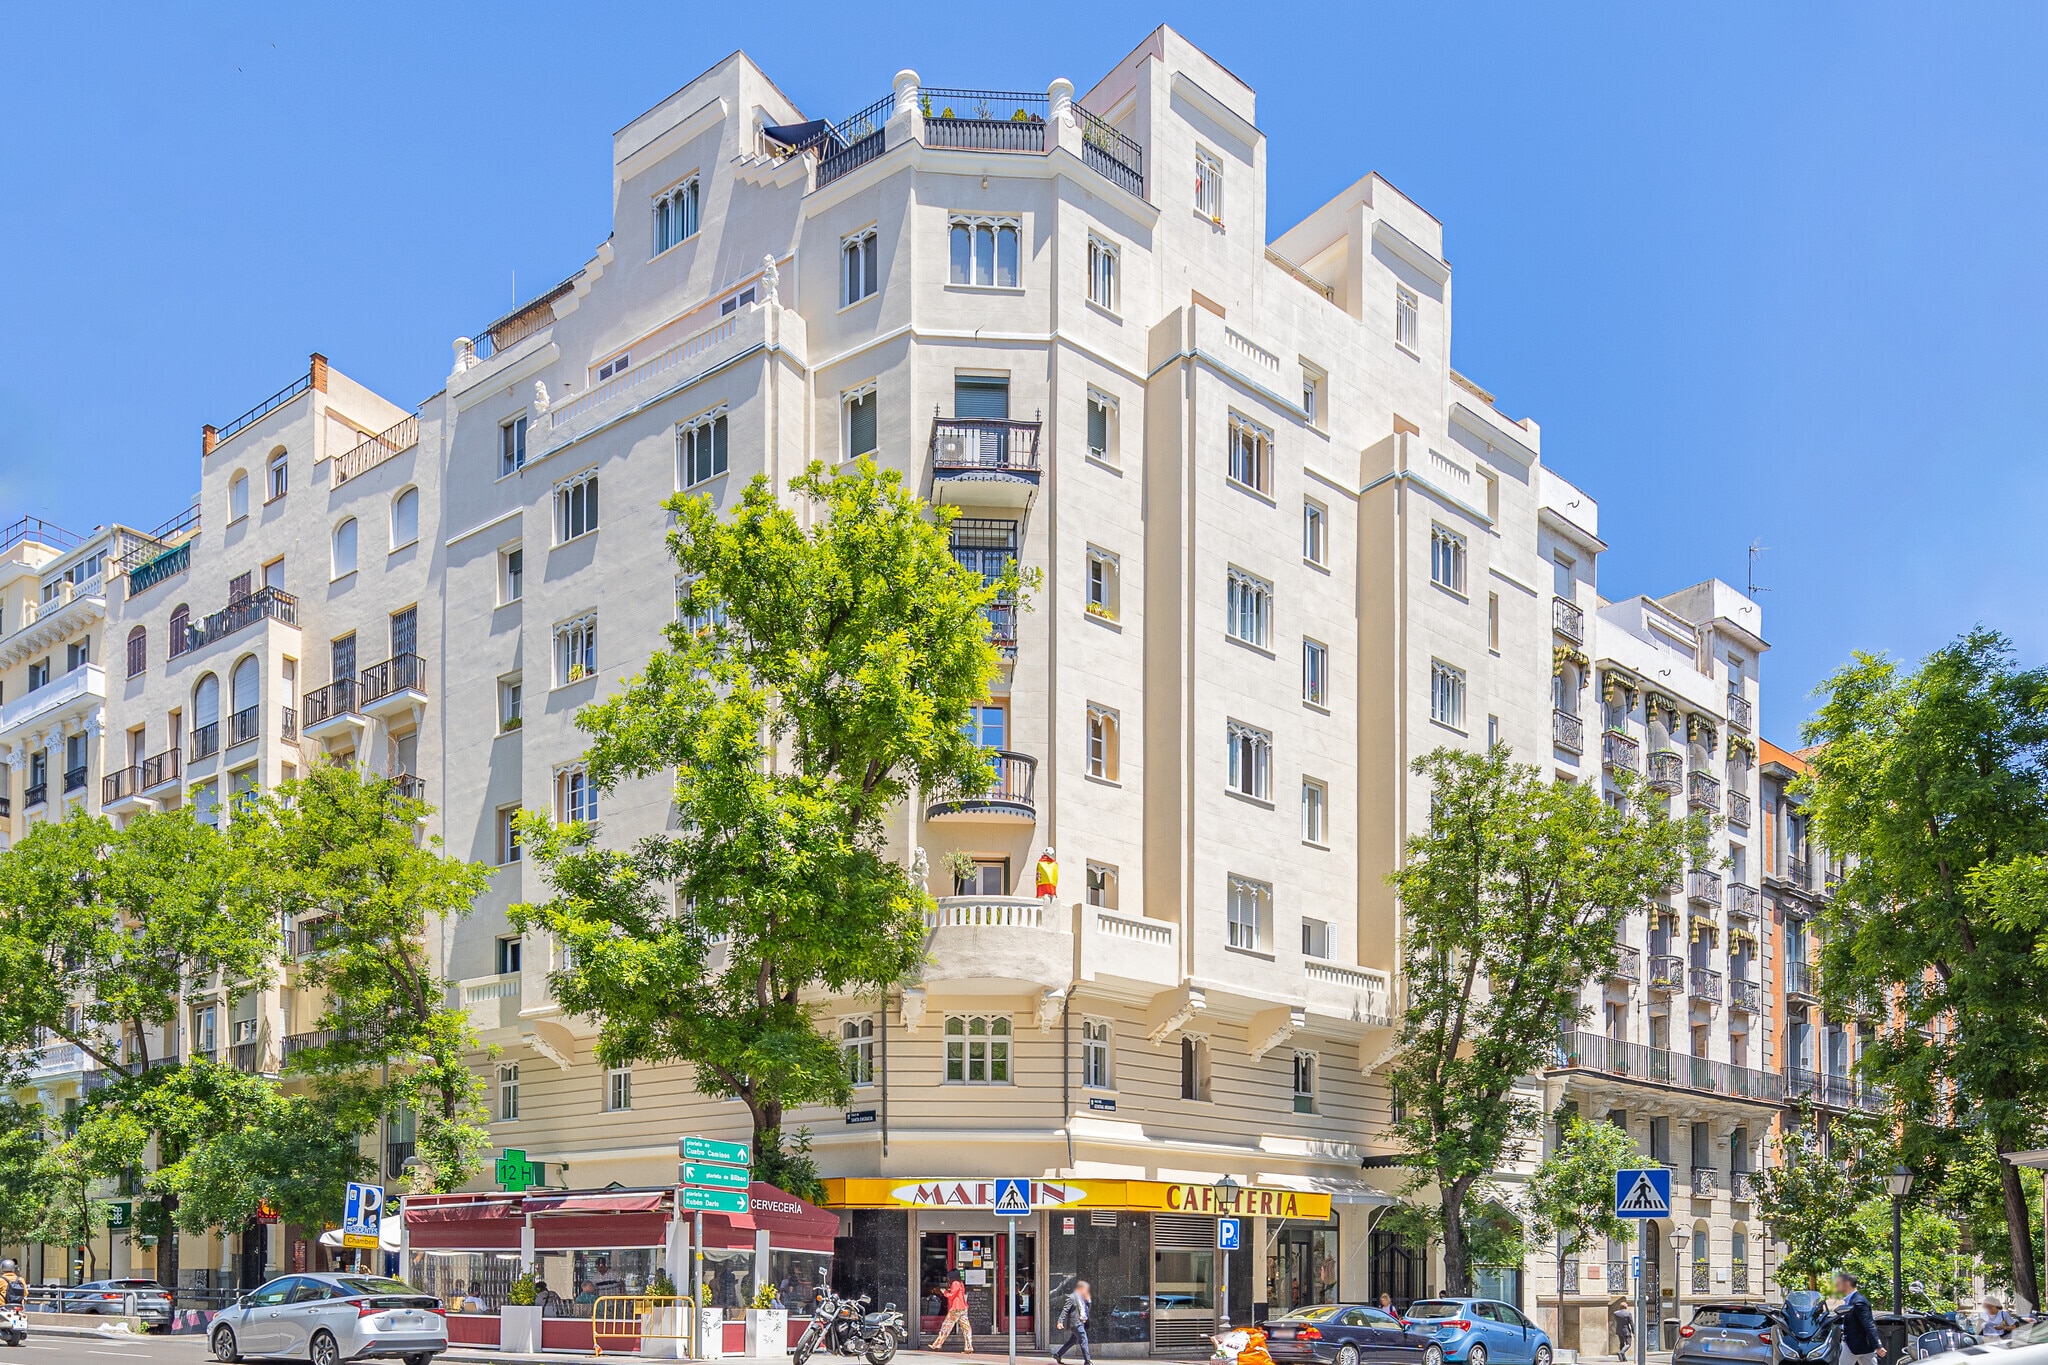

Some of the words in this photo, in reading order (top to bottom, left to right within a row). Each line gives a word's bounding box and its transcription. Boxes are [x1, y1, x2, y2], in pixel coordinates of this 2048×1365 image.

[686, 1147, 705, 1156] Cuatro
[707, 1149, 730, 1159] Caminos
[500, 1164, 516, 1180] 12
[521, 1166, 532, 1181] H
[730, 1174, 747, 1182] Bilbao
[912, 1182, 1065, 1206] MARIN
[750, 1198, 803, 1215] CERVECERÍA
[1222, 1222, 1235, 1245] P
